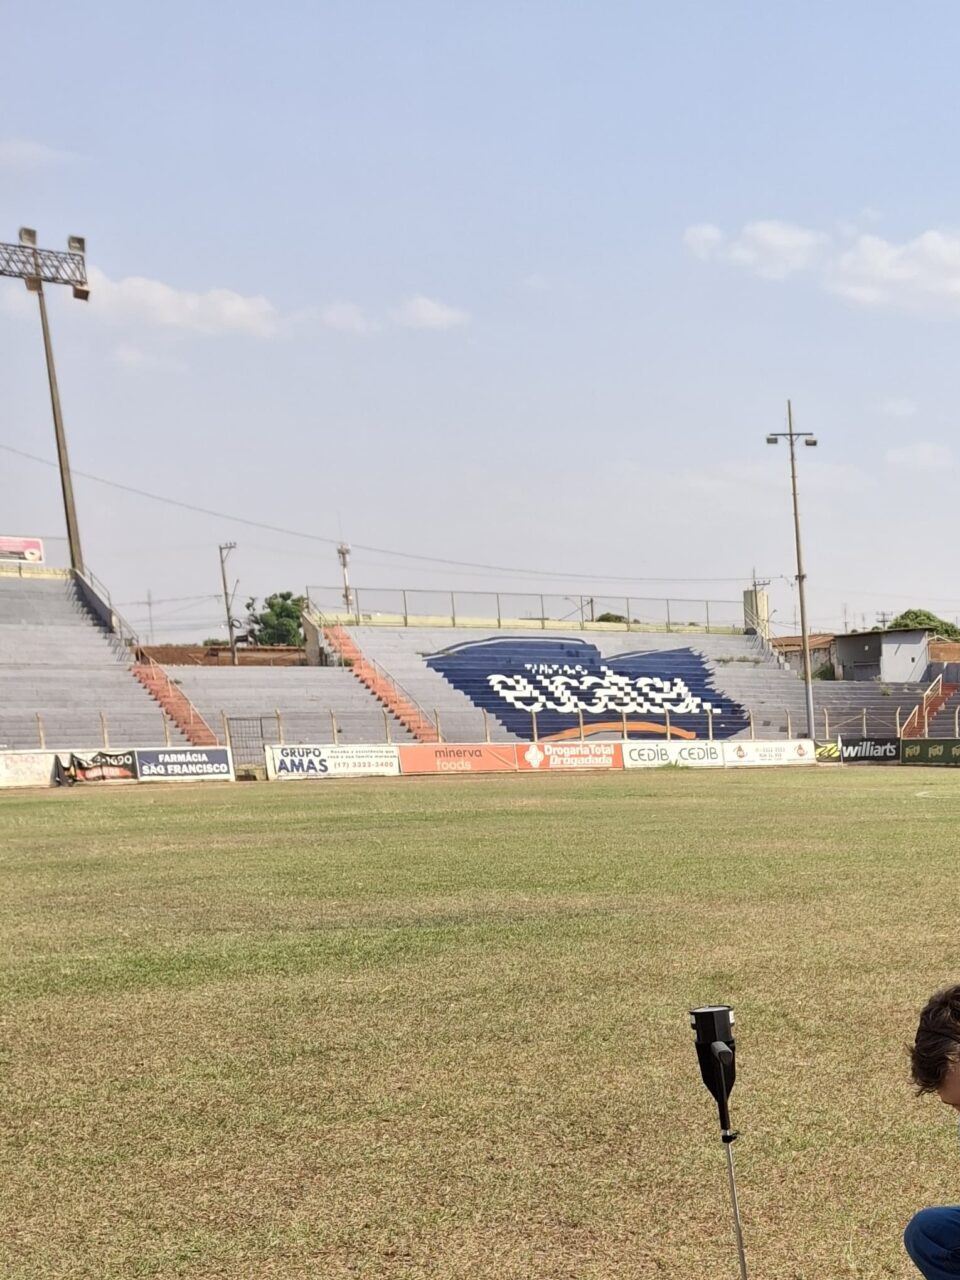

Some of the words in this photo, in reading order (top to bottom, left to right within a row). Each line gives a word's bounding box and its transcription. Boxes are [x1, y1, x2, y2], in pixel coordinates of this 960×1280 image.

[280, 748, 321, 758] GRUPO
[434, 747, 483, 758] minerva
[842, 741, 896, 758] williarts
[158, 751, 209, 762] FARMÁCIA
[167, 763, 228, 774] FRANCISCO
[278, 758, 328, 773] AMAS
[436, 759, 472, 770] foods
